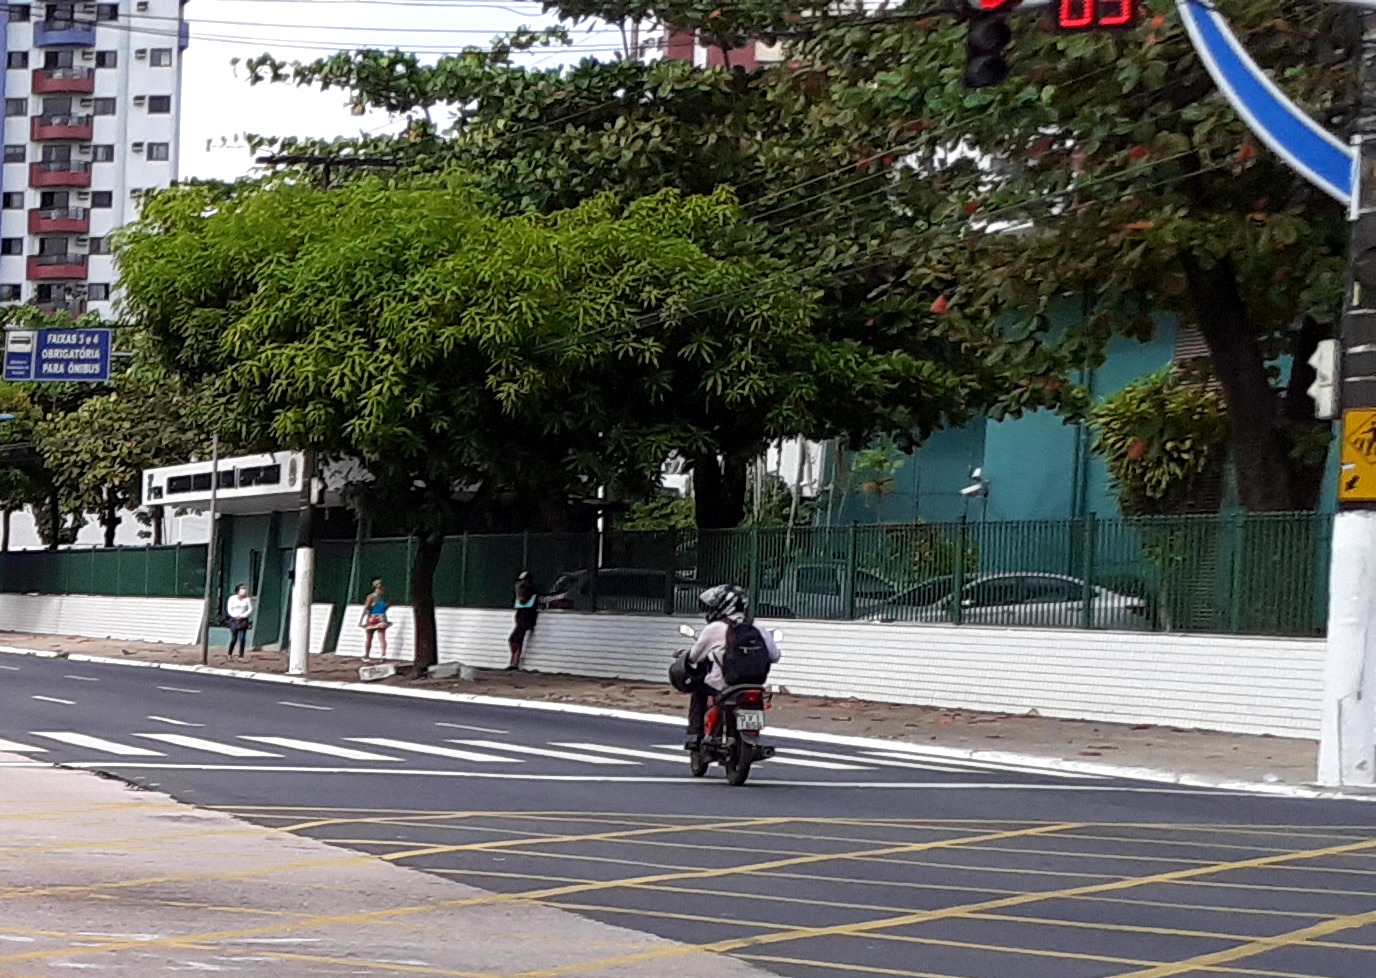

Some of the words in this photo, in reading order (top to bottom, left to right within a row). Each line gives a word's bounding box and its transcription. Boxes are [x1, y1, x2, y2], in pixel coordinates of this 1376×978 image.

[47, 333, 77, 345] FAIXAS
[78, 334, 84, 345] 3
[92, 334, 99, 344] 4
[41, 345, 100, 359] OBRIGATÓRIA
[42, 363, 65, 374] PARA
[68, 361, 100, 374] ÔNIBUS
